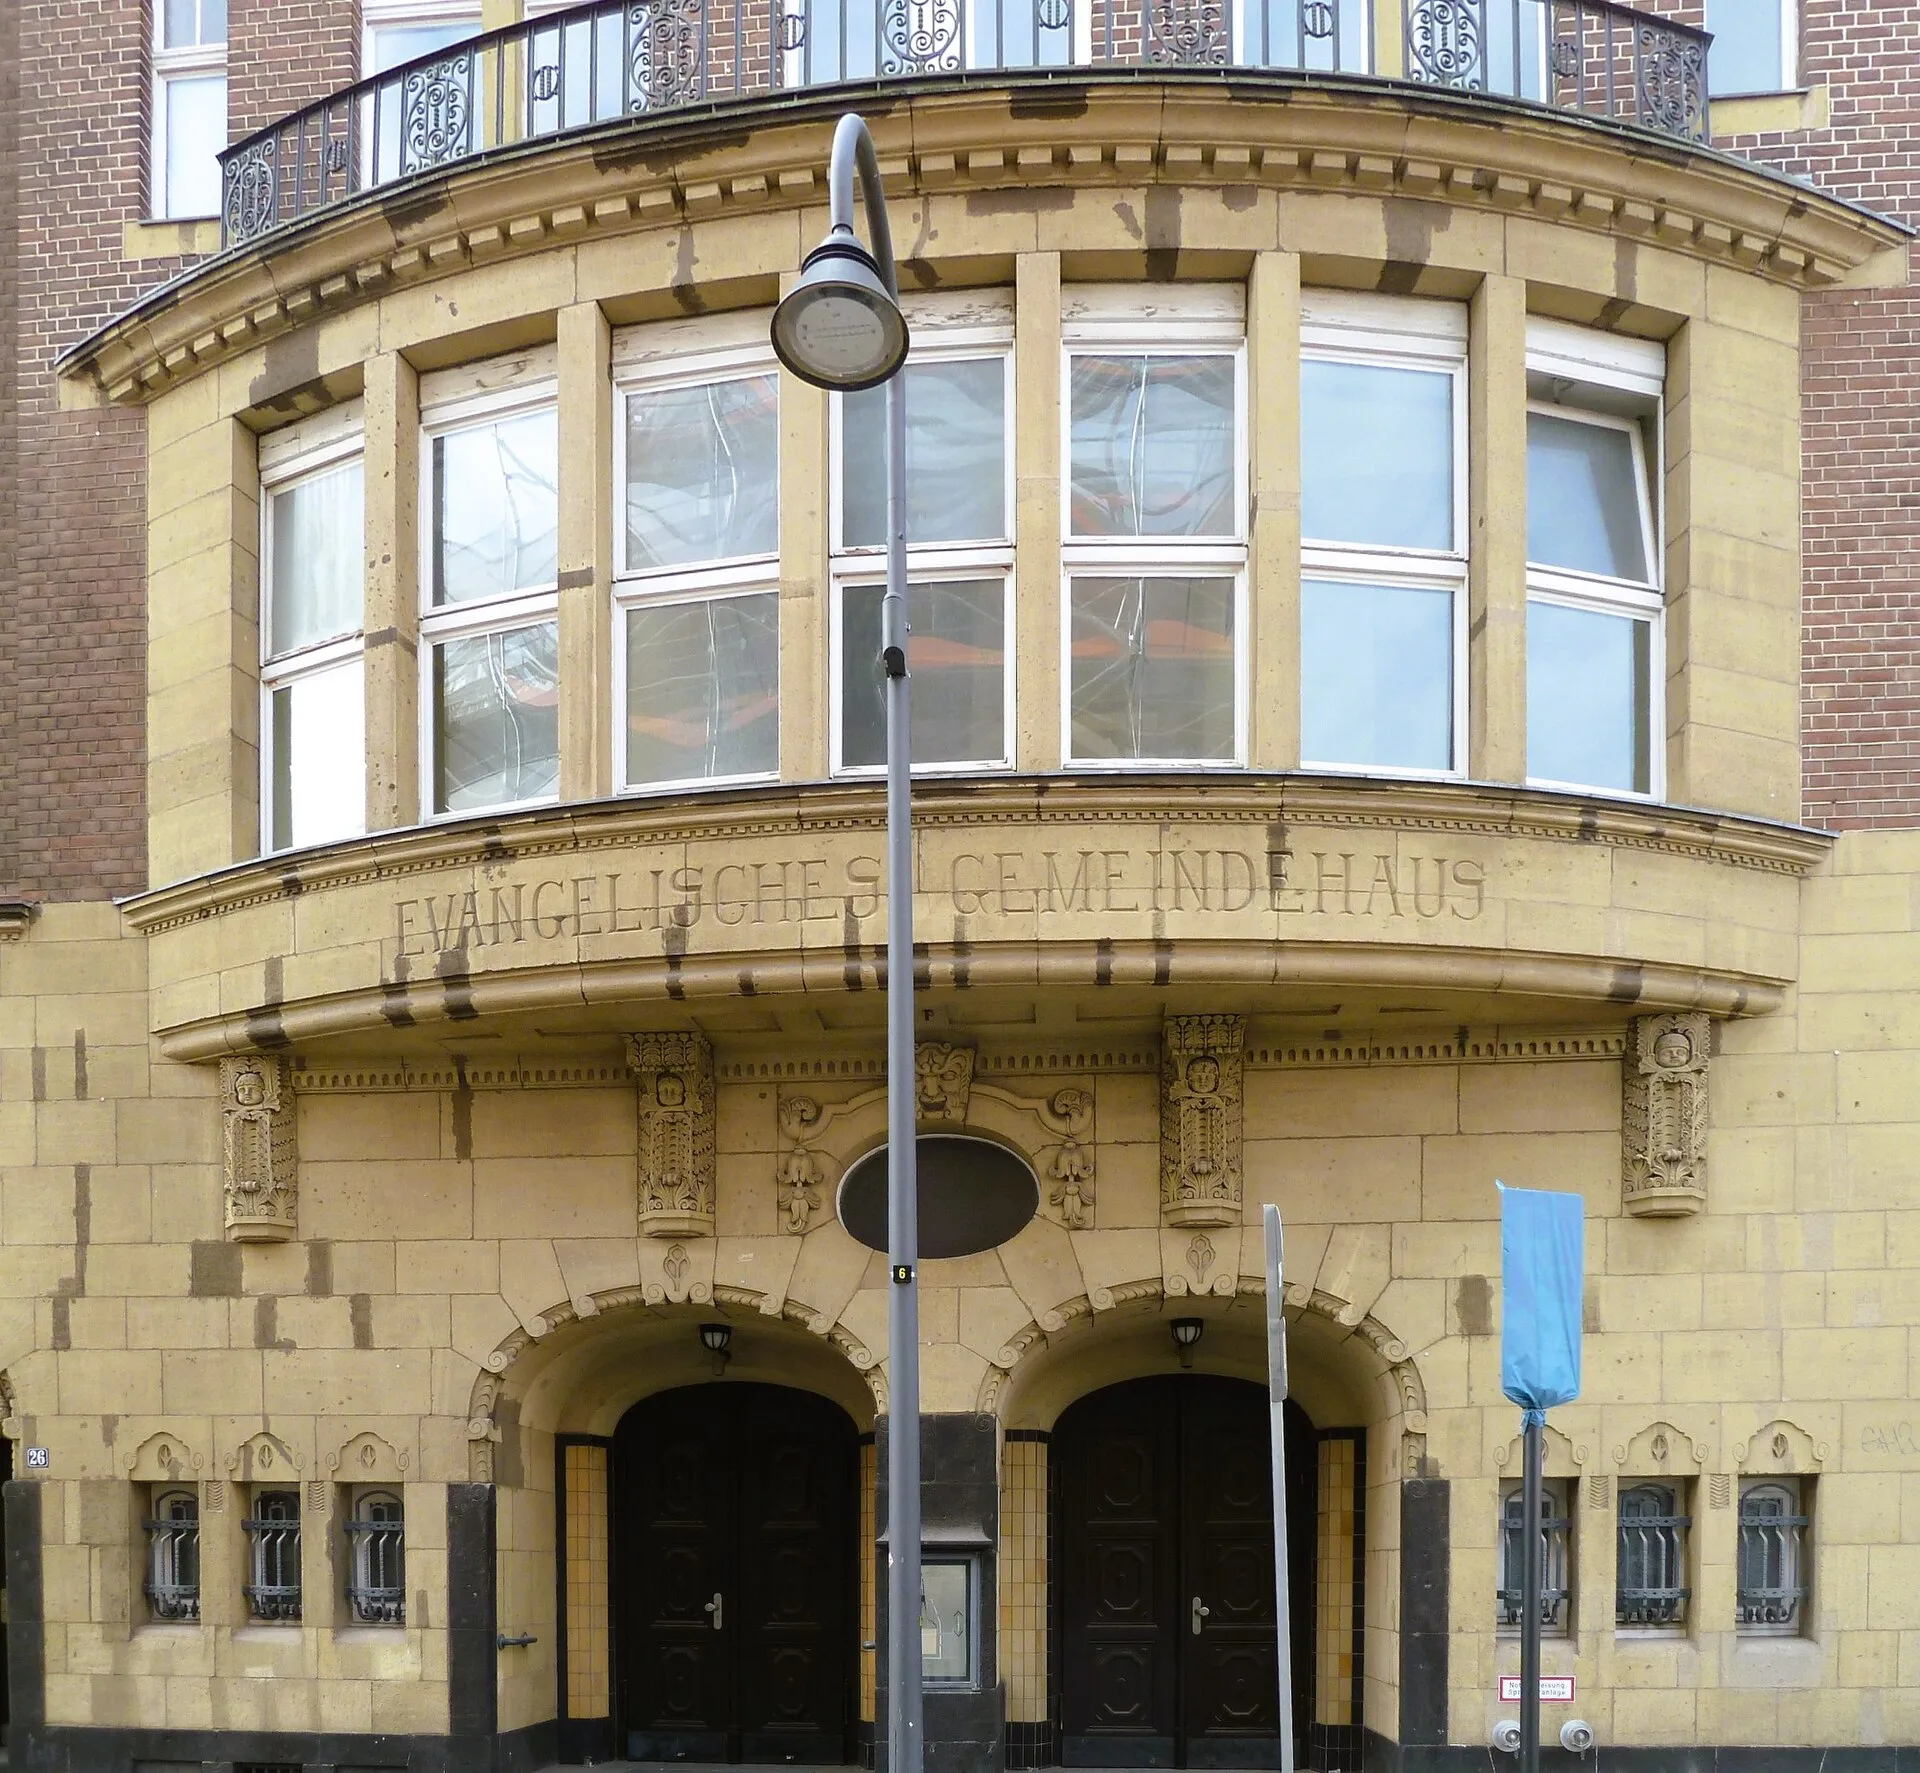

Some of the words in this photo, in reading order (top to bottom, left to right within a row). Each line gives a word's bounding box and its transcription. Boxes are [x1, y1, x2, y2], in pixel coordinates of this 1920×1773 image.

[395, 855, 882, 958] EVANGELISCHES
[950, 848, 1487, 921] GEMEINDEHAUS
[899, 1267, 906, 1279] 6
[29, 1450, 46, 1465] 26
